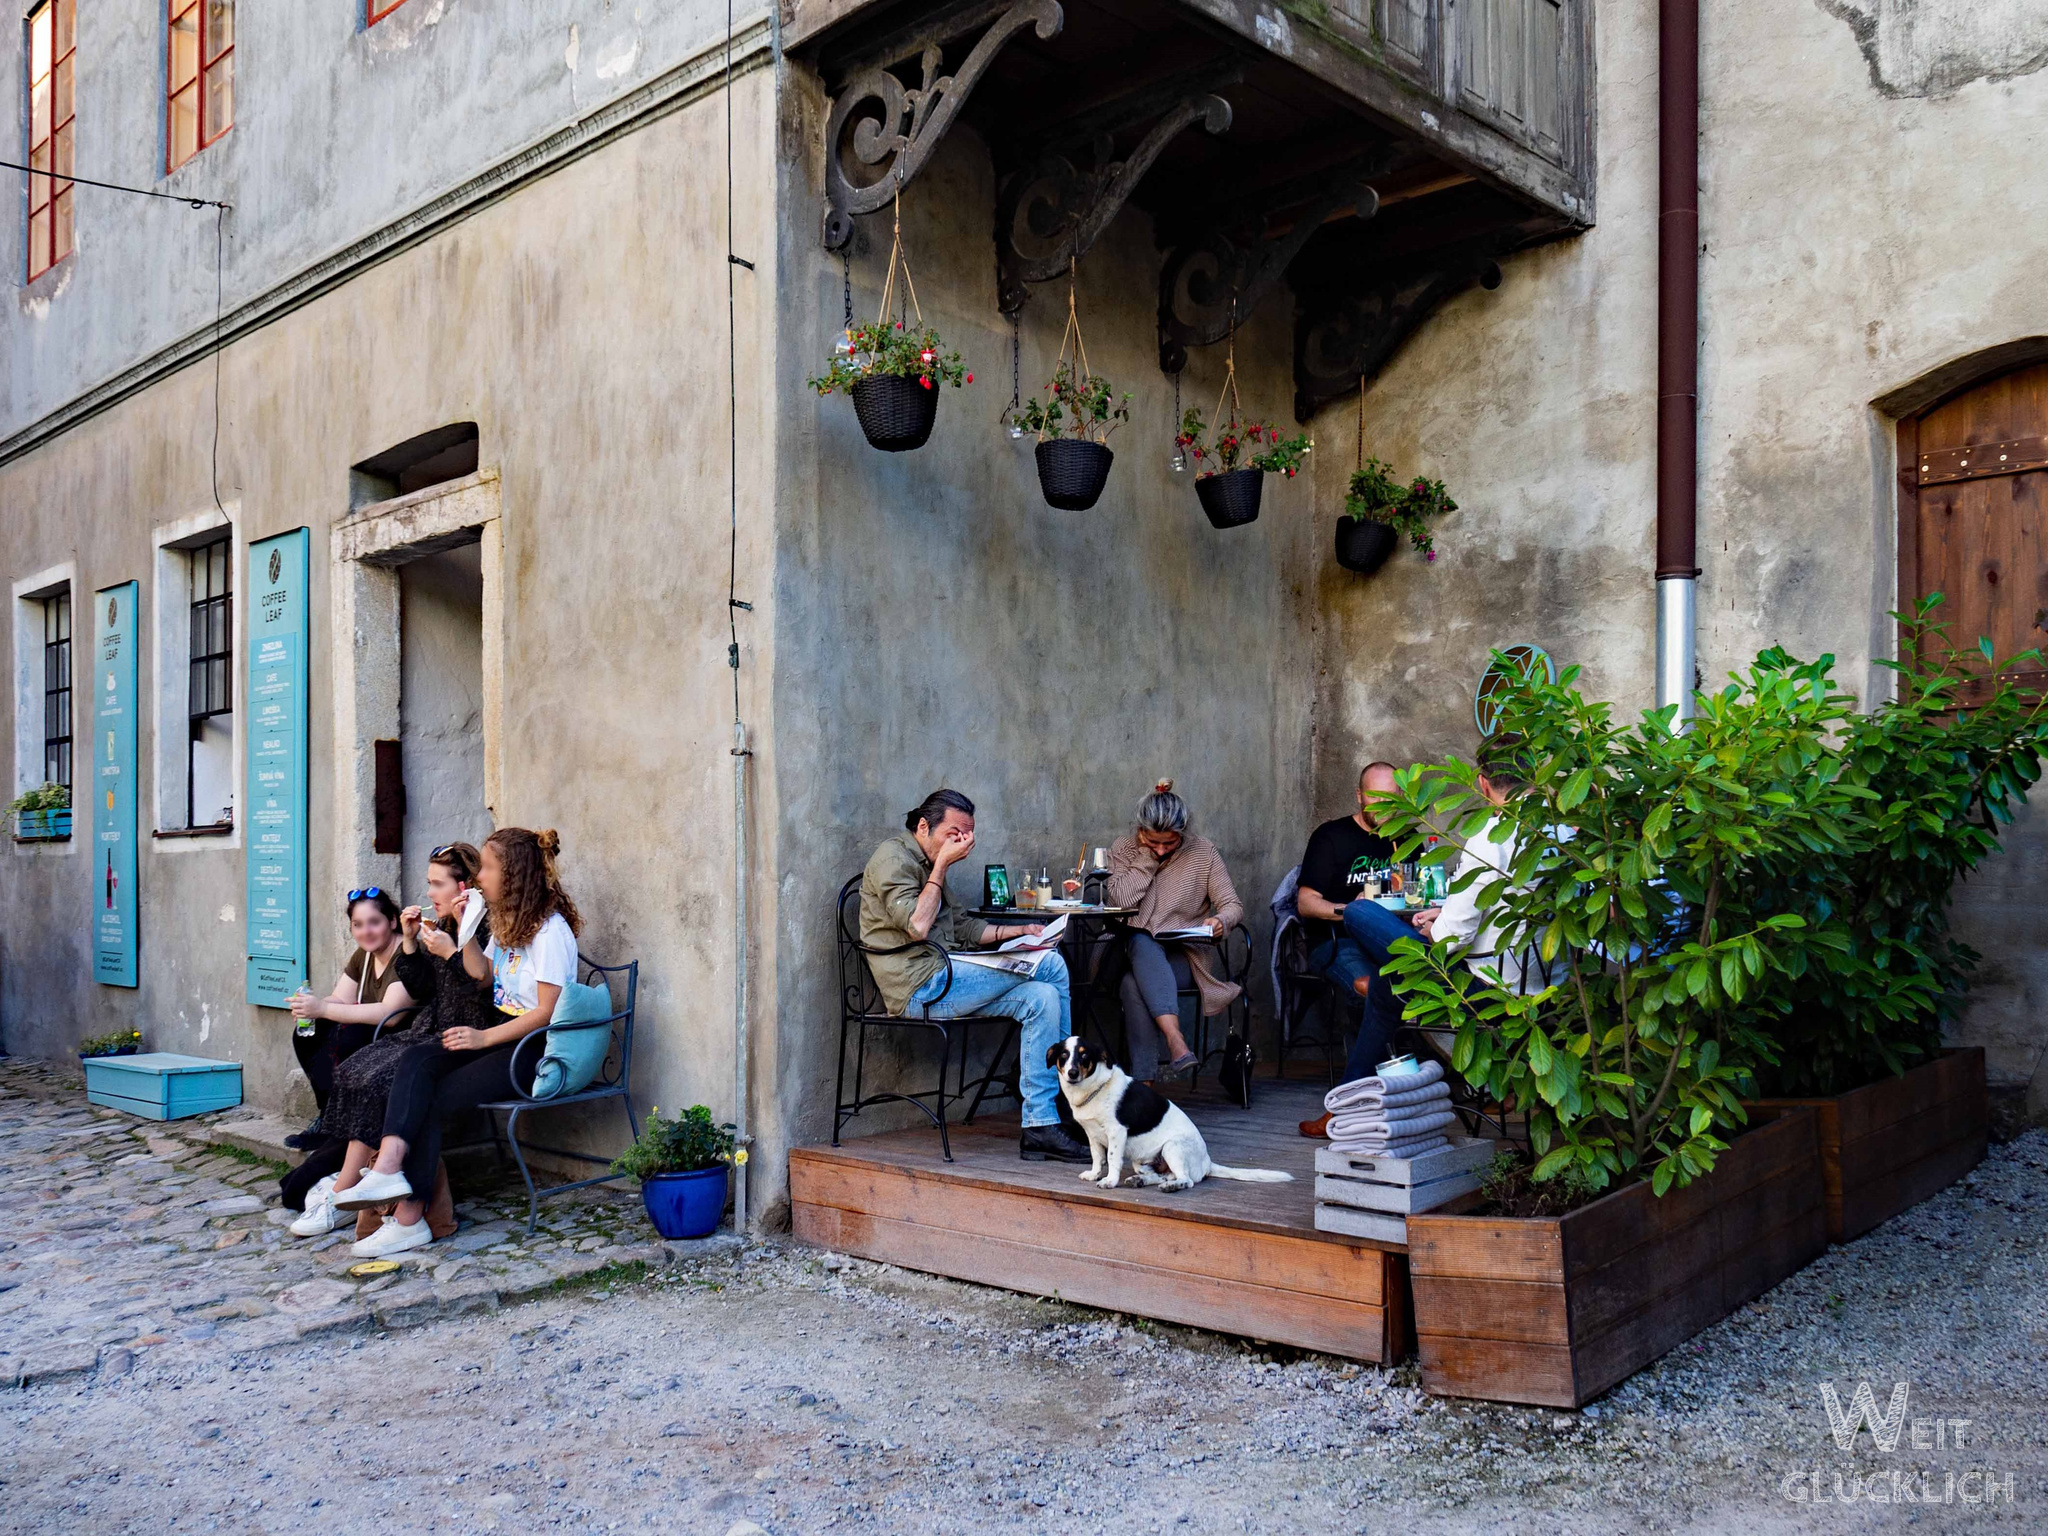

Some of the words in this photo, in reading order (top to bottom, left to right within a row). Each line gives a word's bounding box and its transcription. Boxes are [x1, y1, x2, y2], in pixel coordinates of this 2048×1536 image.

[262, 590, 286, 607] COFFEE
[265, 608, 282, 623] LEAF
[103, 633, 121, 647] COFFEE
[105, 648, 118, 661] LEAF
